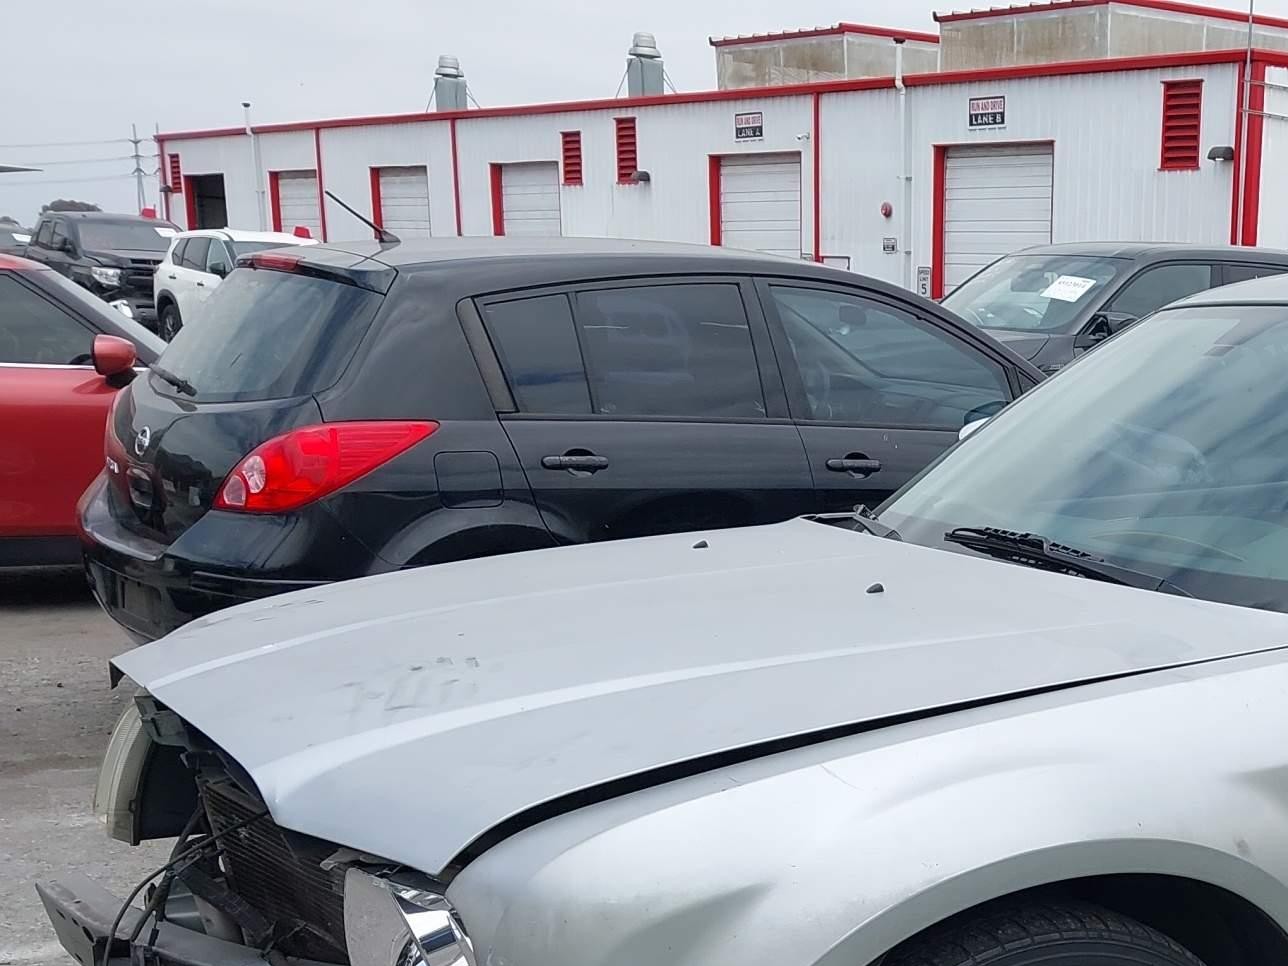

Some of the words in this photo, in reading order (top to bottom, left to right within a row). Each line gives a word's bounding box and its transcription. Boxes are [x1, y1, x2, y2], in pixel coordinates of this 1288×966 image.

[972, 113, 994, 125] LANE
[996, 113, 1002, 123] B
[737, 128, 754, 137] LANE
[921, 283, 927, 295] 5
